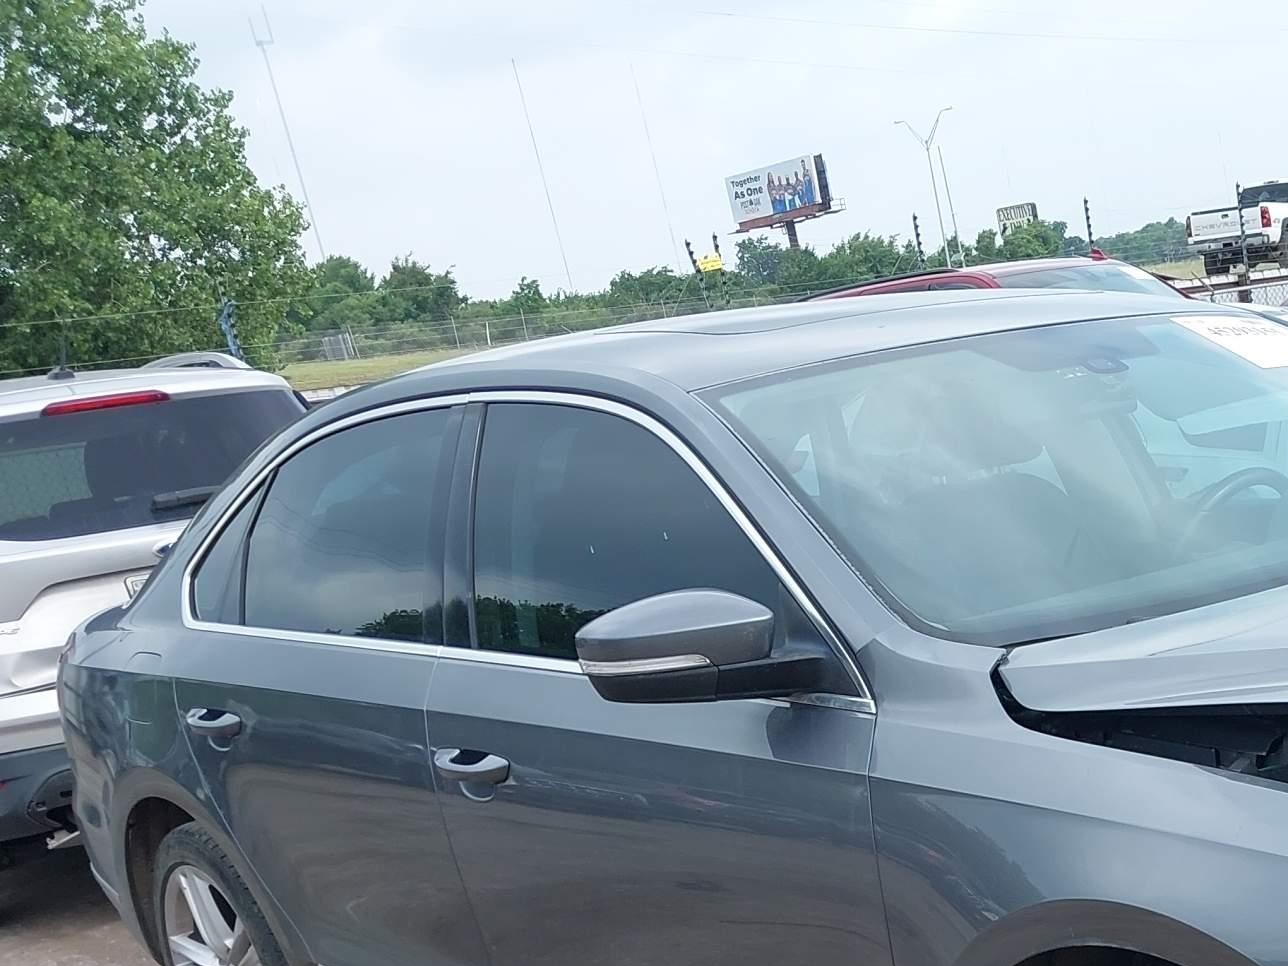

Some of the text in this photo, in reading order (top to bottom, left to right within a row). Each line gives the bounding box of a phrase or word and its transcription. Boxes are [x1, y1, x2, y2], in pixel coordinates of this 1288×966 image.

[730, 175, 761, 188] Together
[734, 186, 764, 200] As One
[998, 204, 1033, 222] EXECUTIVE
